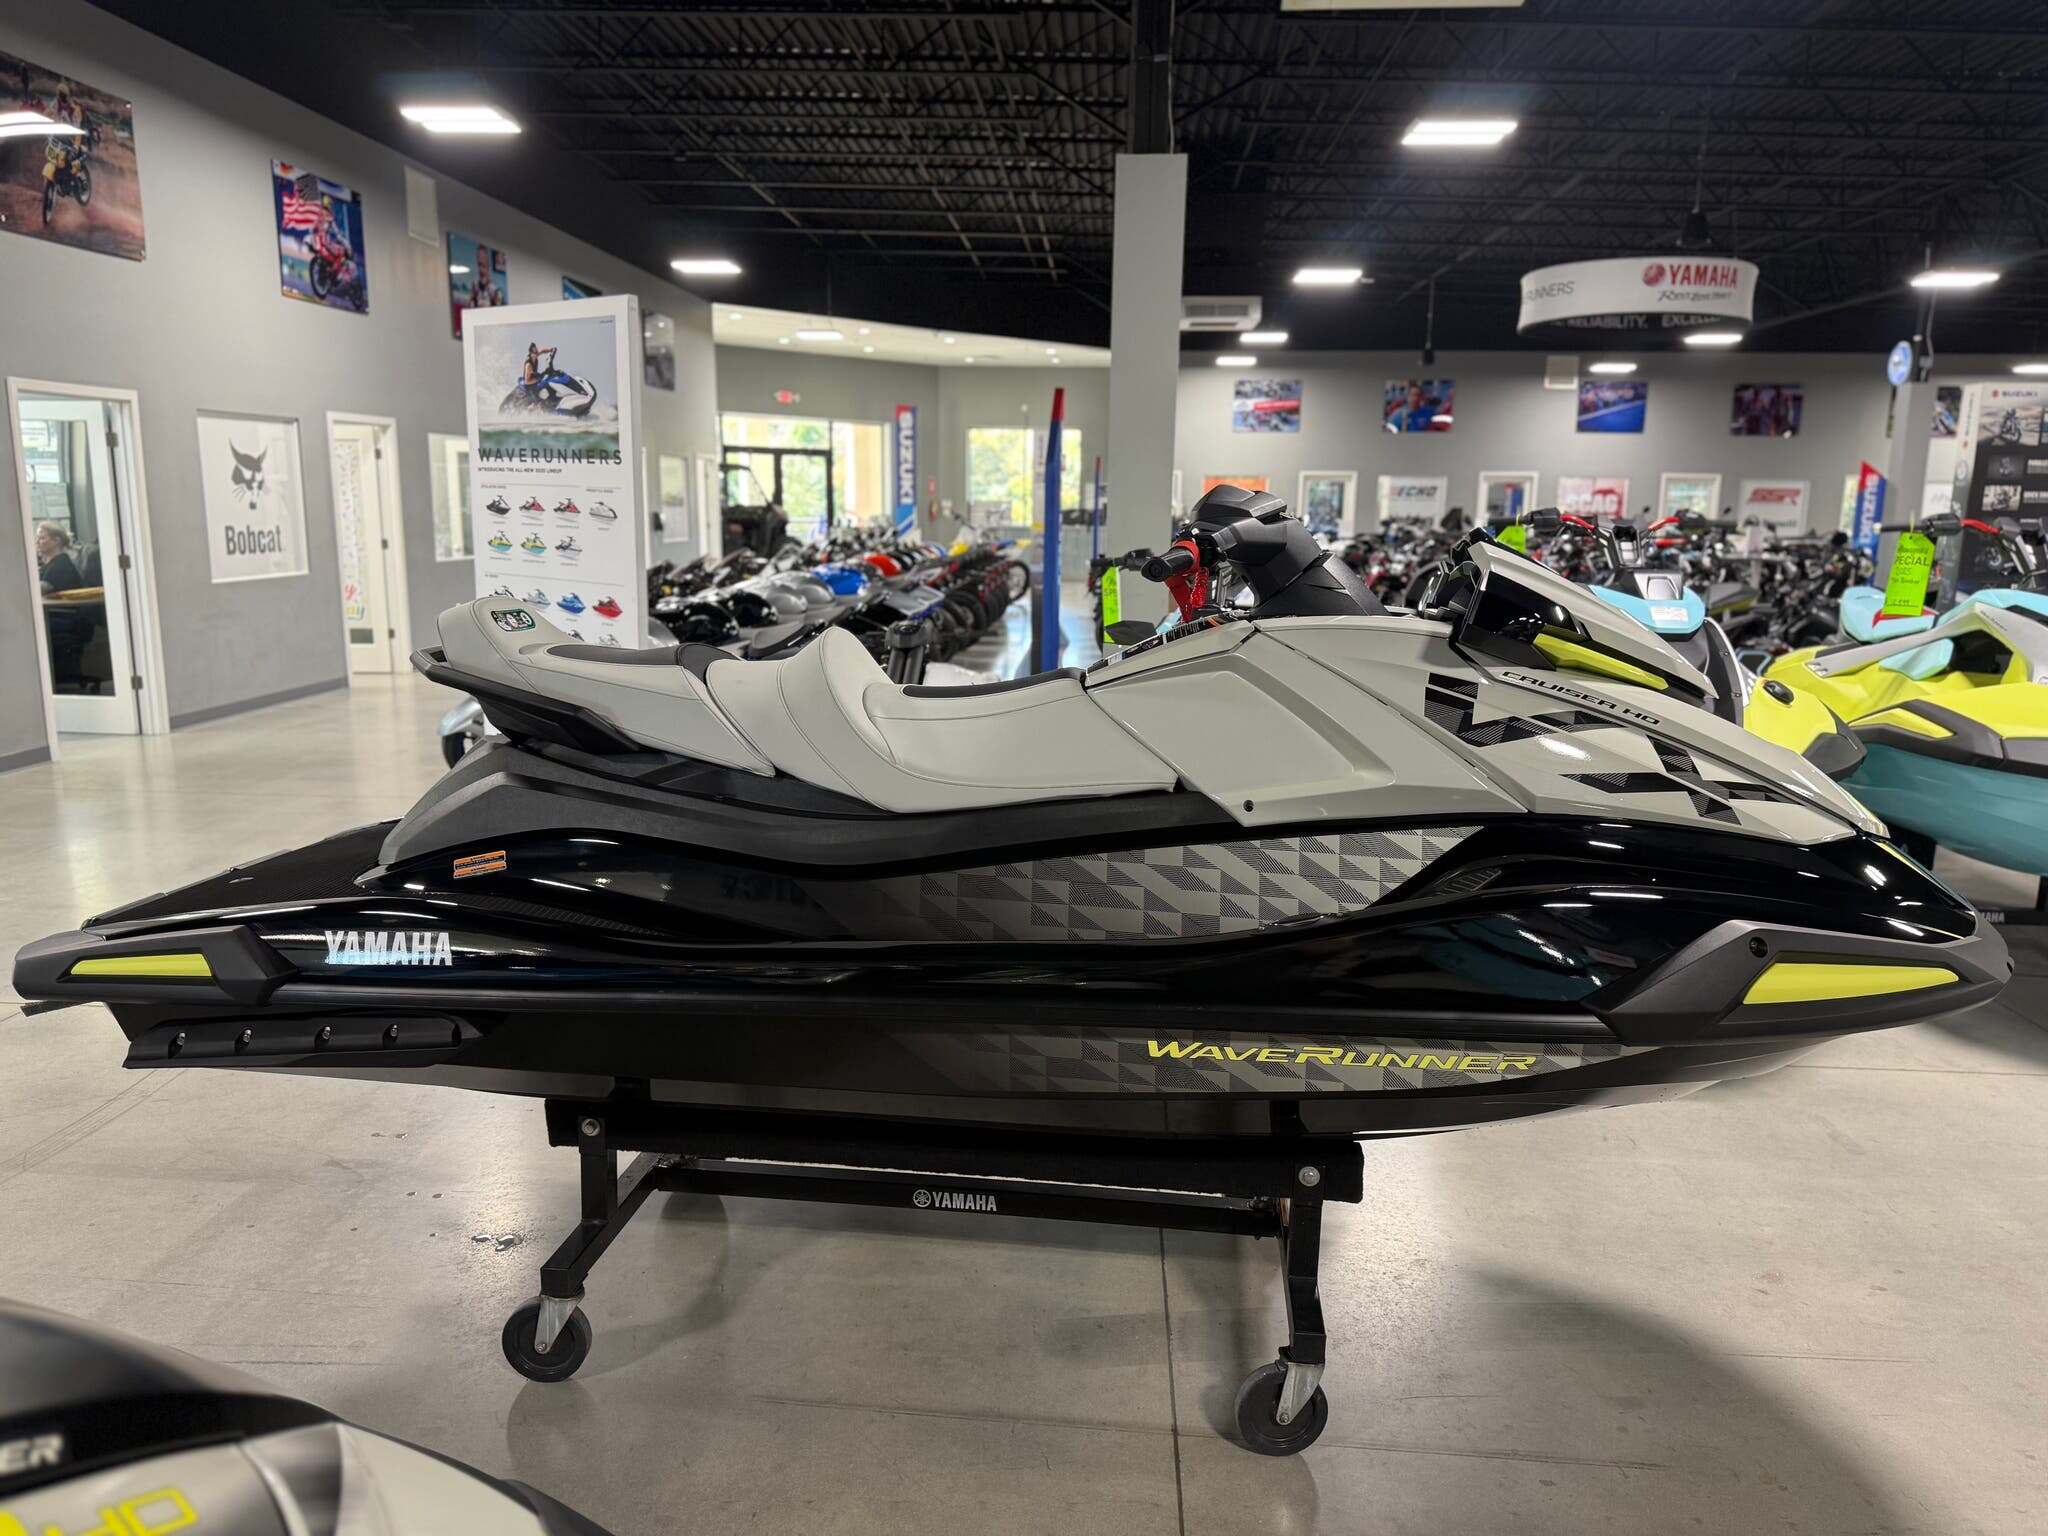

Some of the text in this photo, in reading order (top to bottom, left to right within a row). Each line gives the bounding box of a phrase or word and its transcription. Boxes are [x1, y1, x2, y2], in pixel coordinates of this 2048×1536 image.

[1669, 264, 1739, 289] YAMAHA
[478, 447, 623, 465] WAVERUNNERS
[899, 411, 914, 504] SUZUKI
[224, 524, 282, 556] Bobcat
[1502, 671, 1661, 726] CRUISER HO
[324, 930, 453, 966] YAMAHA
[932, 1191, 997, 1212] YAMAHA
